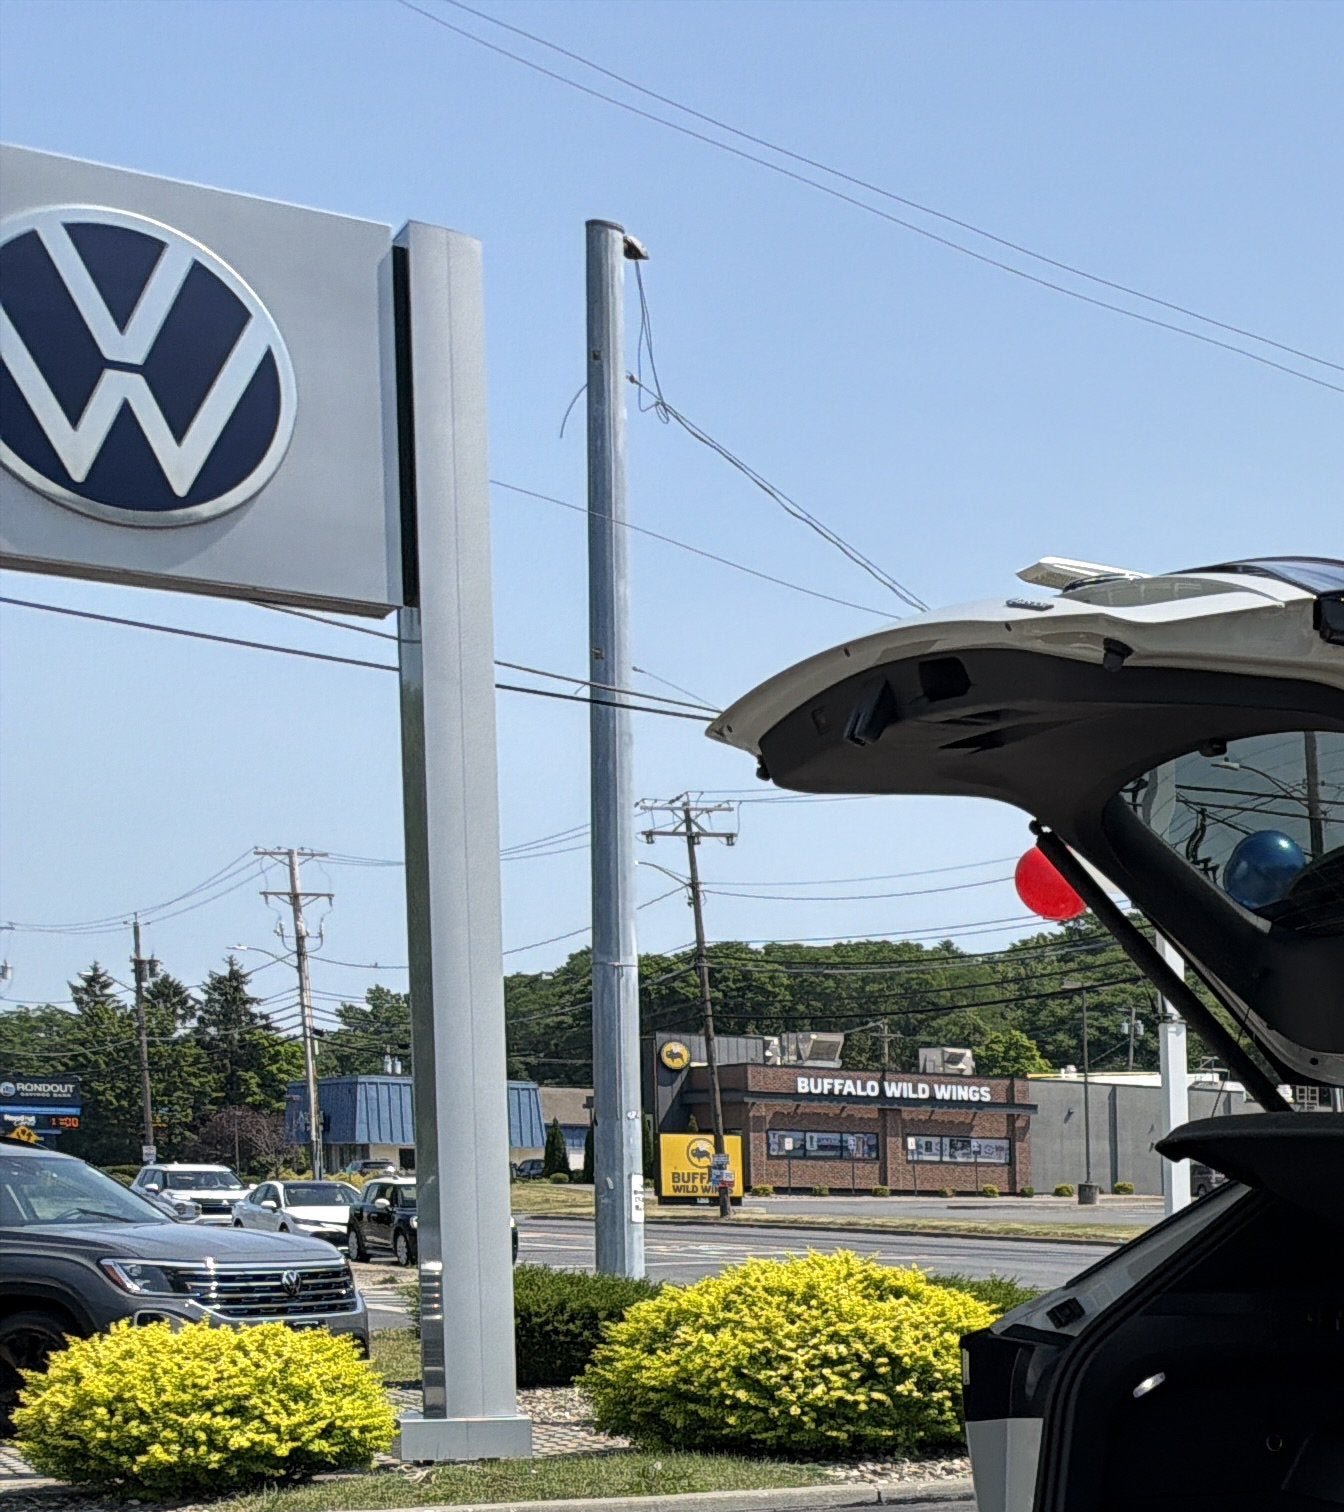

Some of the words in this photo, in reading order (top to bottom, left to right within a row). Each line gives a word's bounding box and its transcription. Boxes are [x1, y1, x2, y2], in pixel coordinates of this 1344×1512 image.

[16, 1083, 75, 1093] RONDOUT
[797, 1077, 880, 1097] BUFFALO
[884, 1081, 930, 1099] WILD
[934, 1084, 991, 1101] WINGS
[672, 1172, 711, 1184] BUFF
[672, 1185, 698, 1194] WILD
